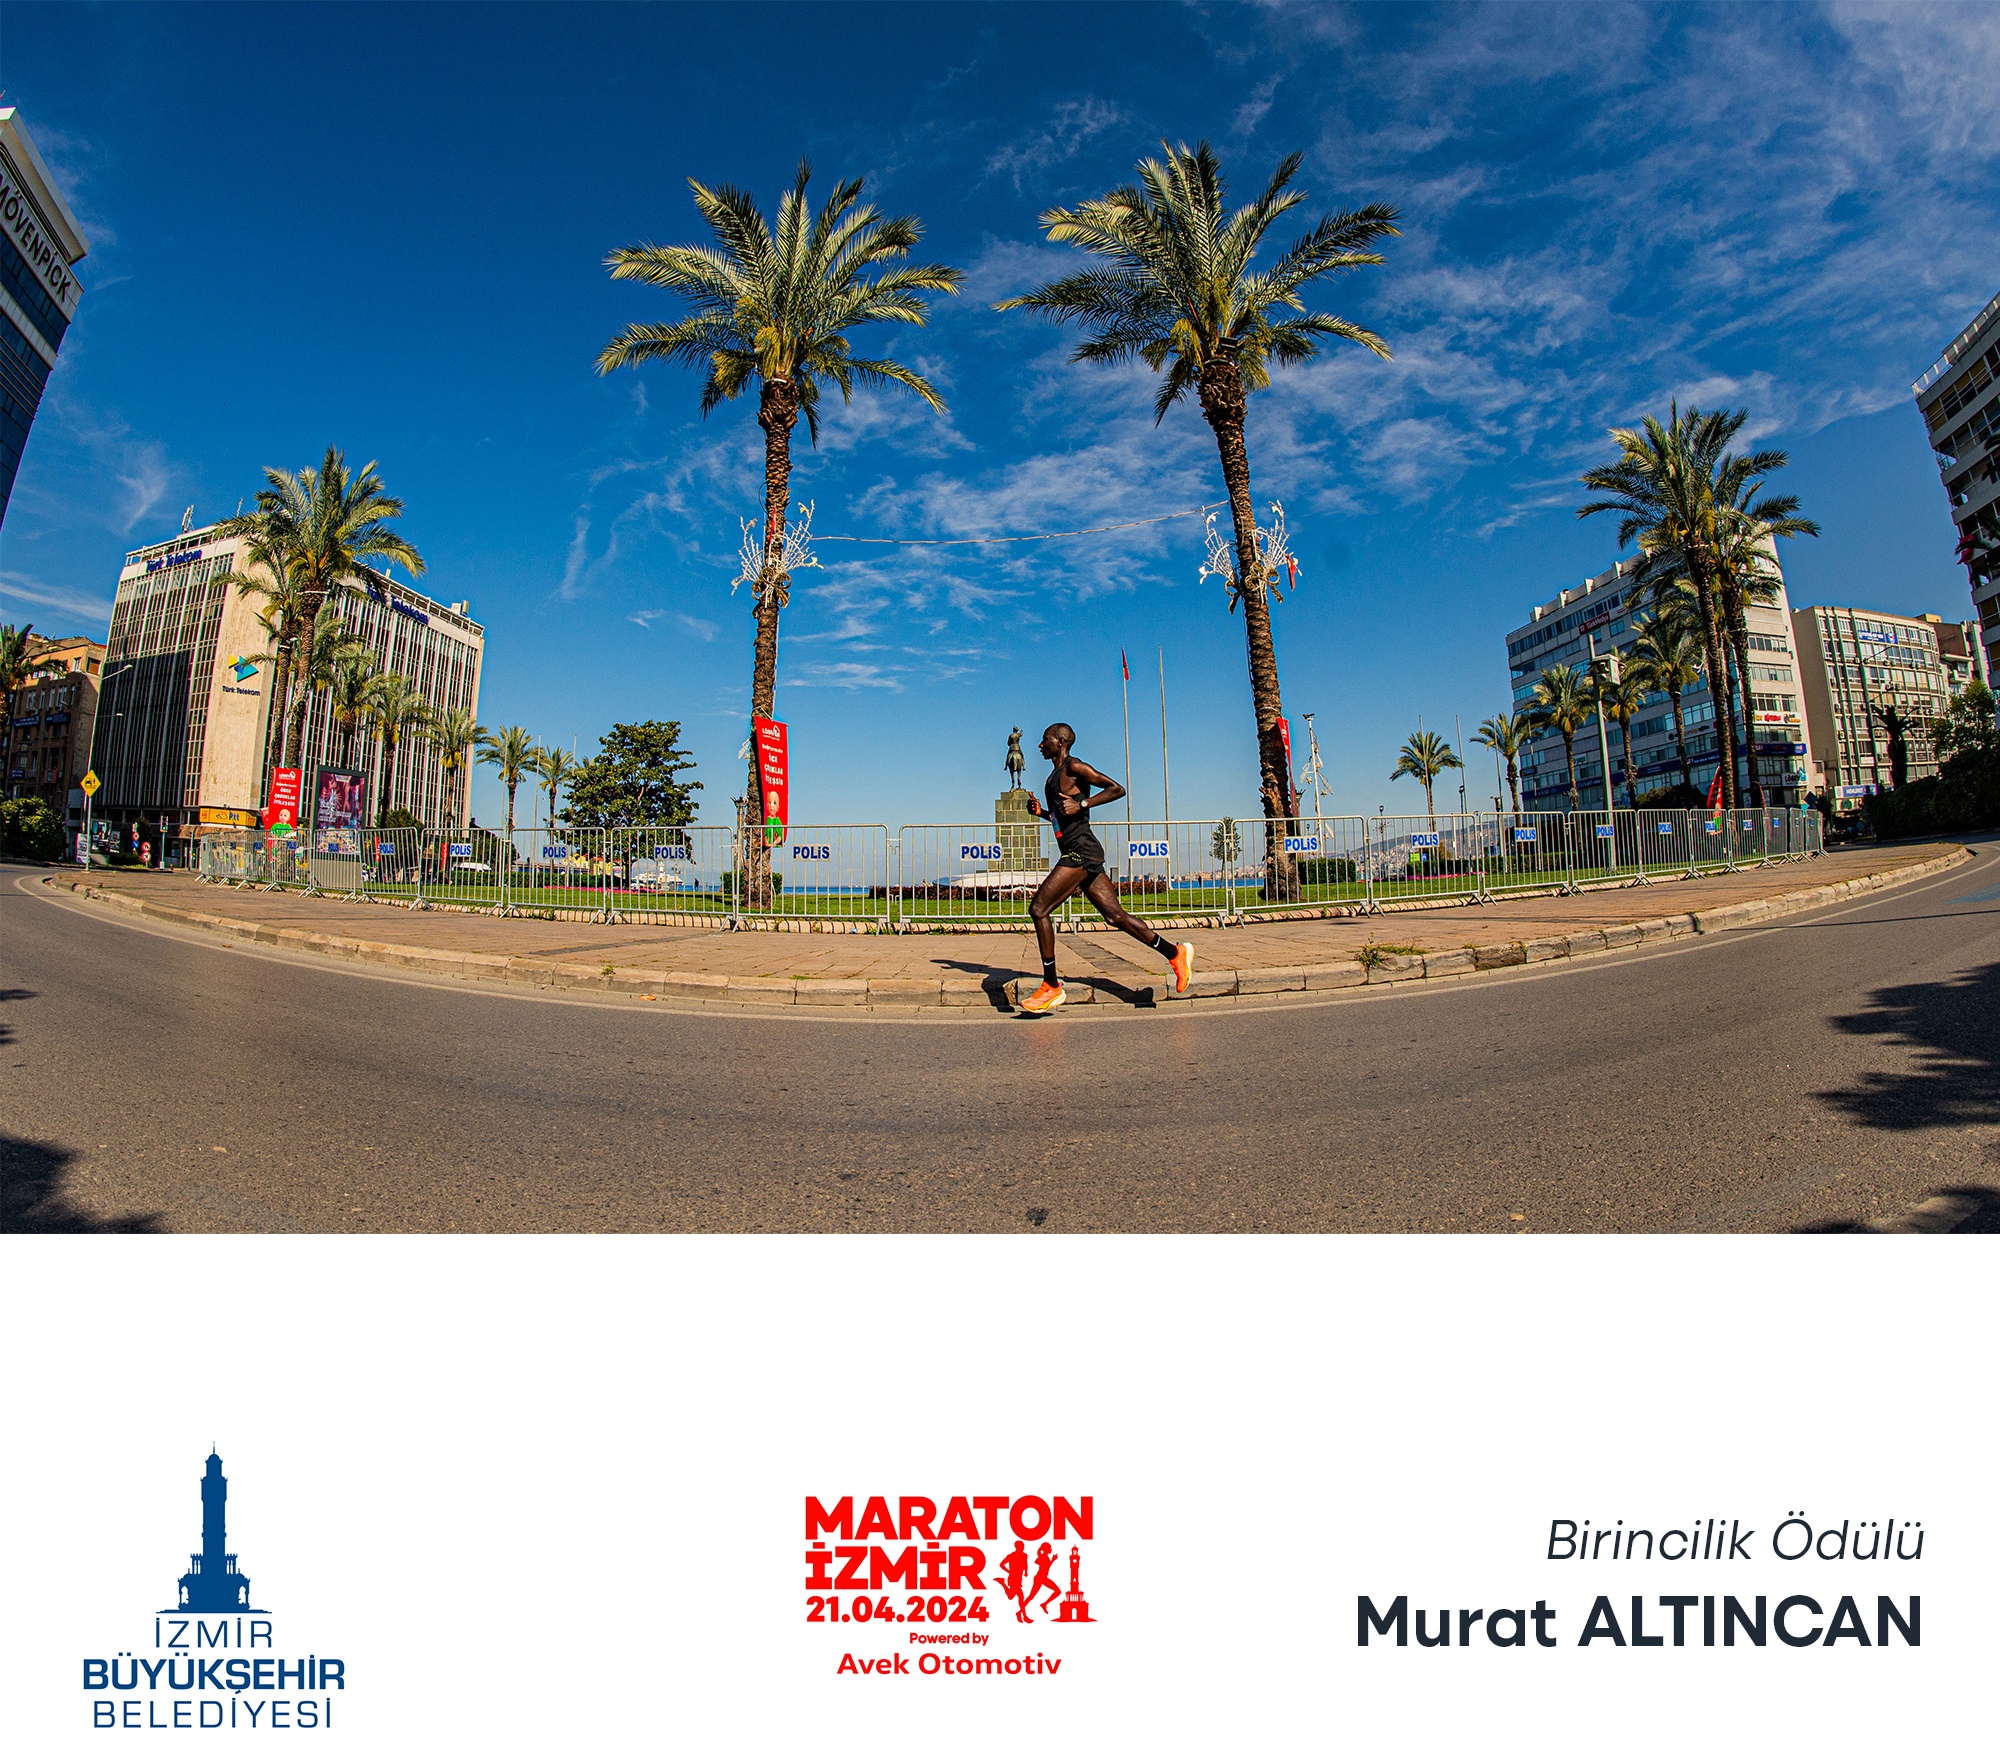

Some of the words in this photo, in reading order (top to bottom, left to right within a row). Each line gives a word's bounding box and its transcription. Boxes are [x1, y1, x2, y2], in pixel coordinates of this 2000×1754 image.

[145, 557, 164, 573] Türk
[165, 549, 202, 567] Telekom
[391, 594, 428, 625] Telekom
[222, 685, 235, 693] Türk
[236, 687, 261, 696] Telekom
